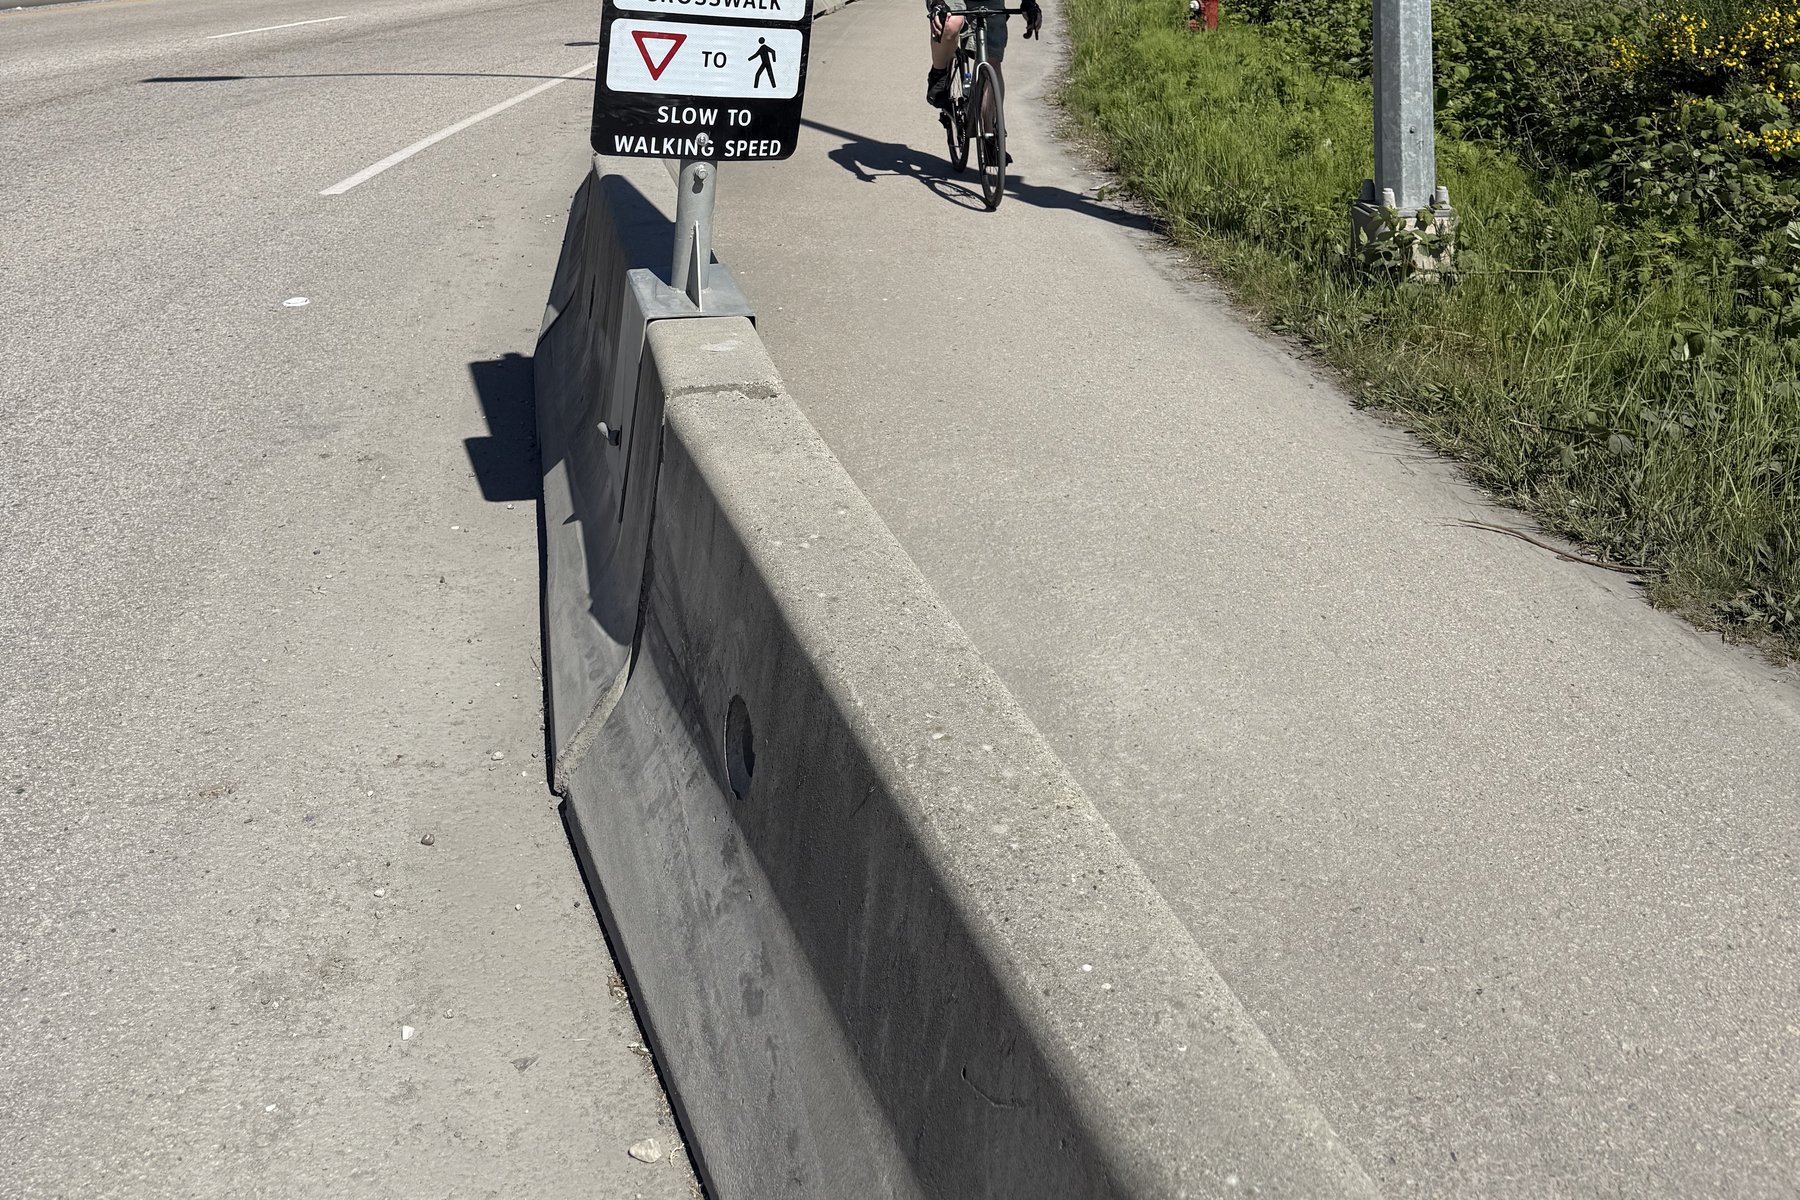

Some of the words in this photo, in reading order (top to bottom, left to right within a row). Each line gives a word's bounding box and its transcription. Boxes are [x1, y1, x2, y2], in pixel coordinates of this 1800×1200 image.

[701, 50, 727, 69] TO
[656, 105, 718, 126] SLOW
[728, 109, 752, 127] TO
[614, 135, 715, 157] WALKING
[724, 139, 782, 157] SPEED
